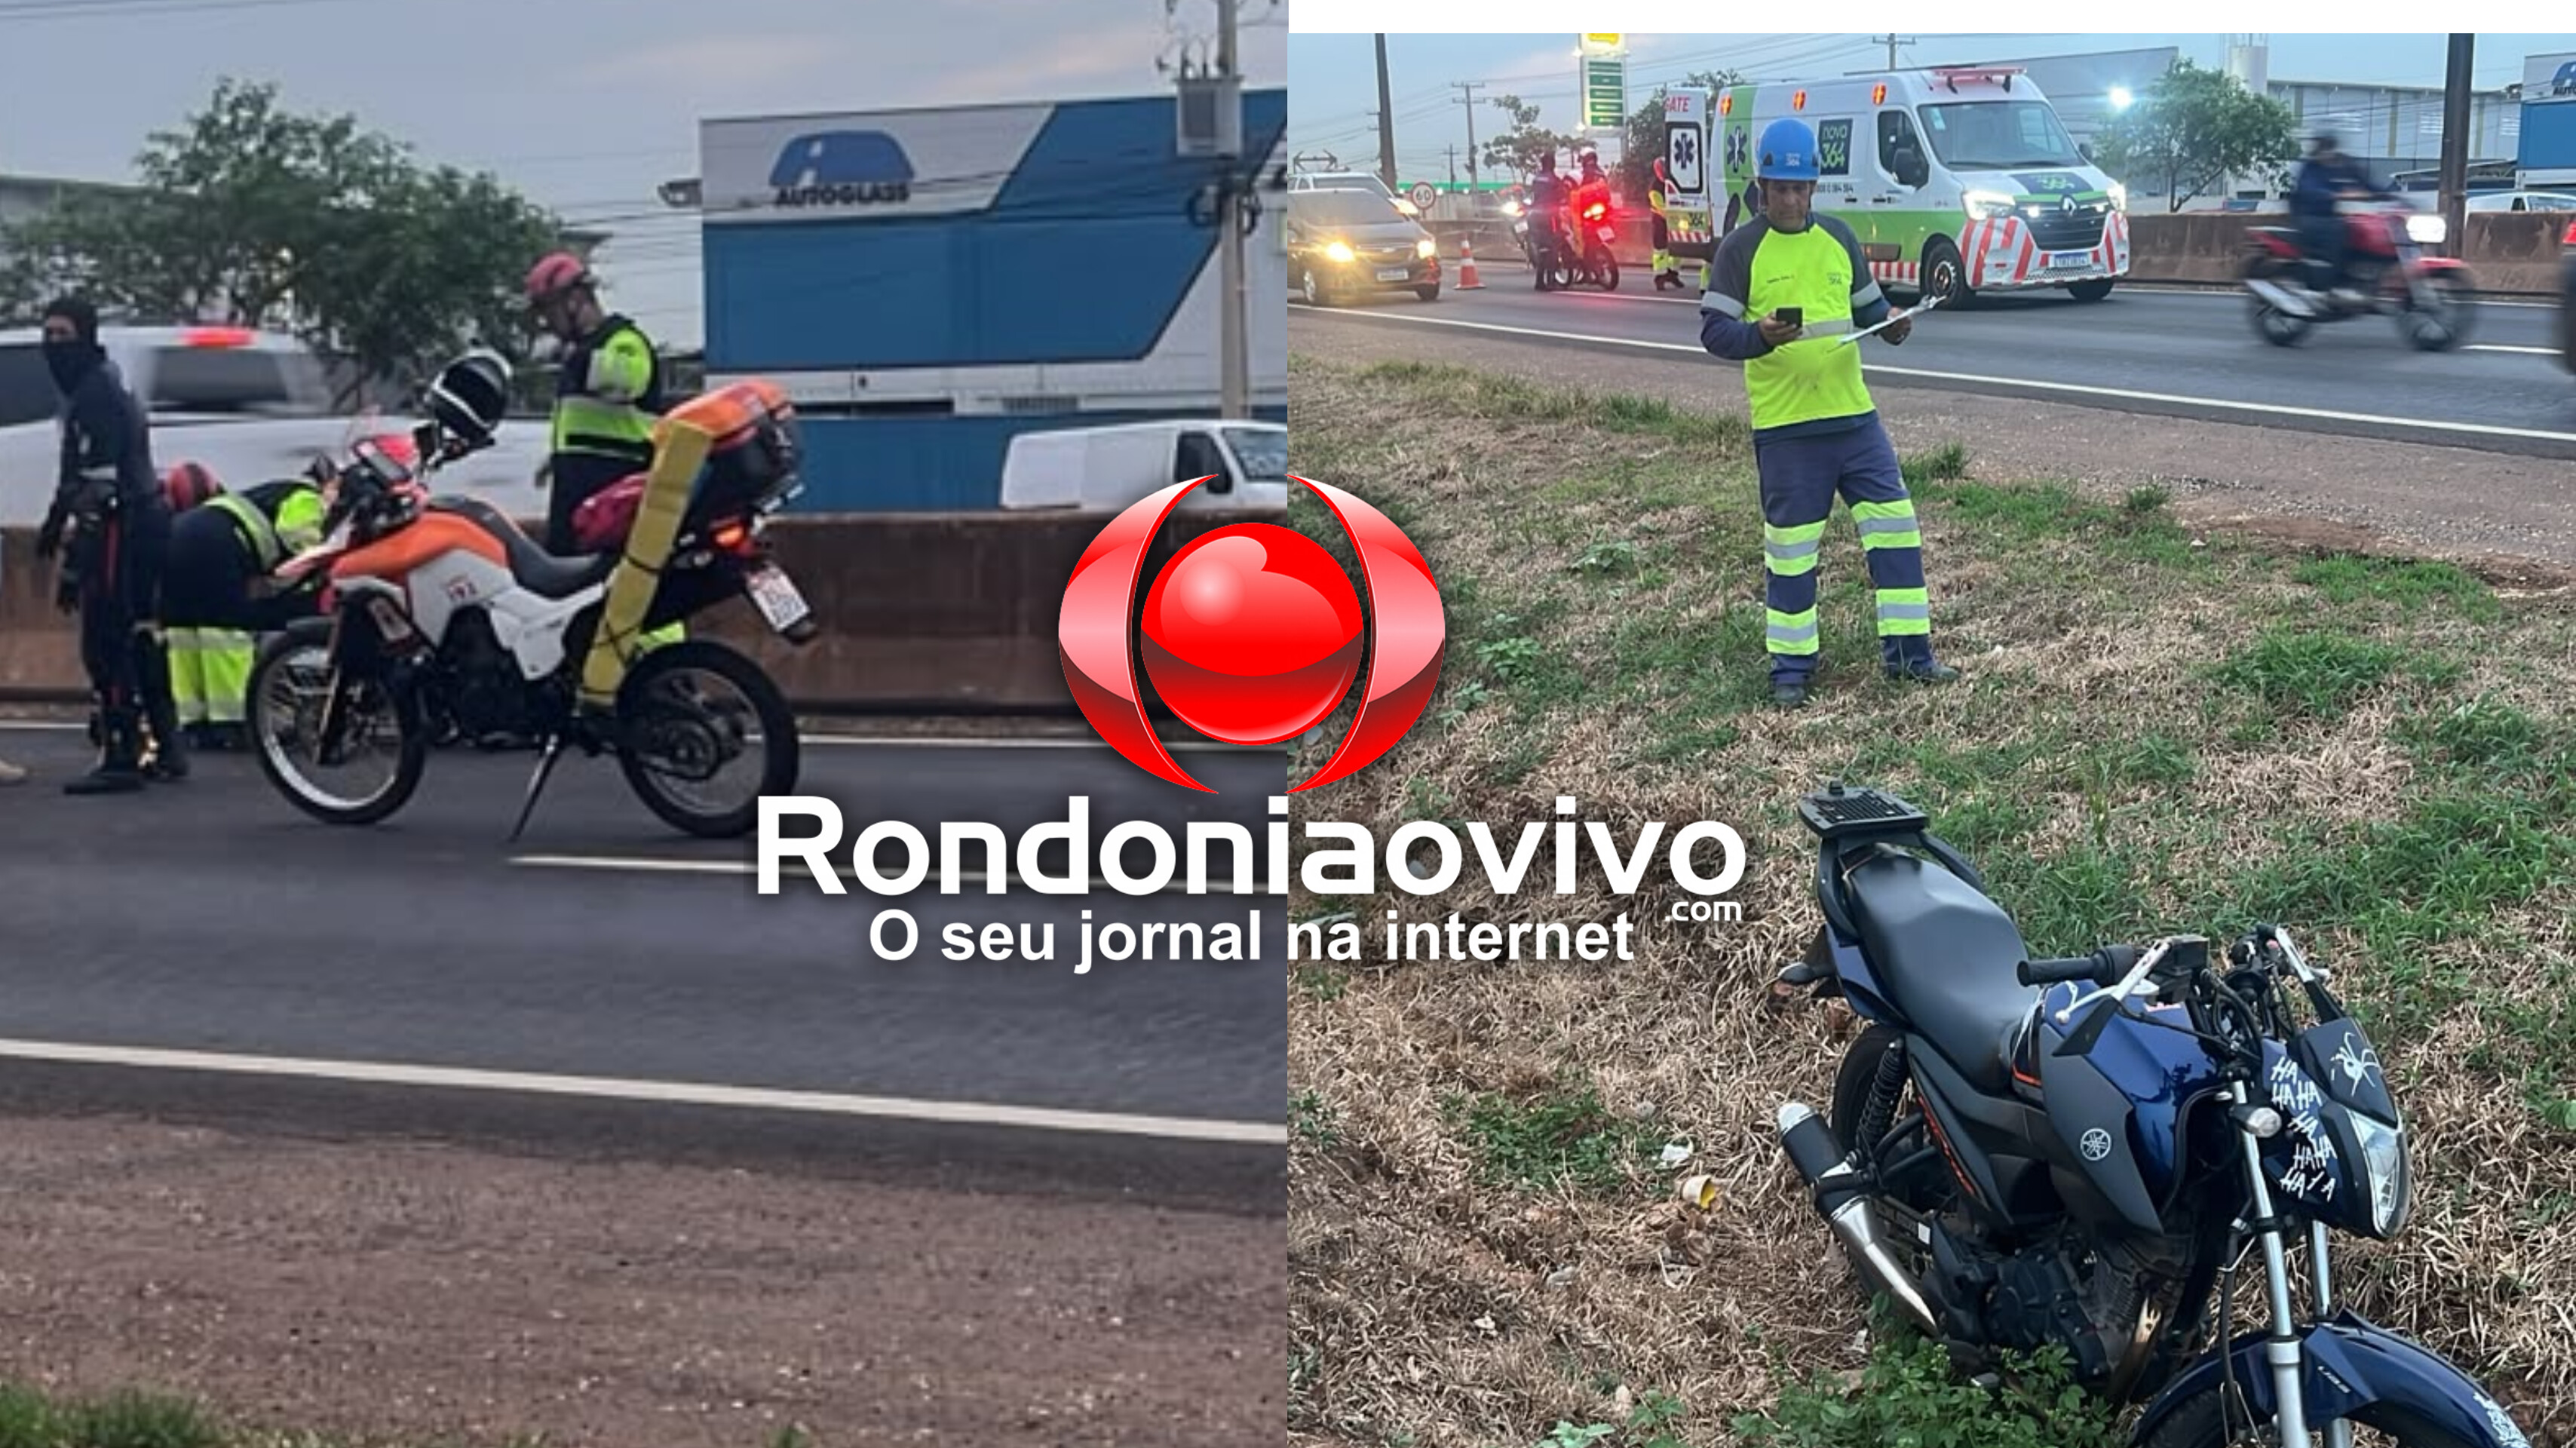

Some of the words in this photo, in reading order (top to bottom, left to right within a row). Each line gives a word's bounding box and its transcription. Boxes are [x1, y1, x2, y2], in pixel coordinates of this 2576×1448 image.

[775, 183, 909, 207] AUTOGLASS
[1415, 189, 1431, 203] 60
[2270, 1057, 2298, 1084] HA
